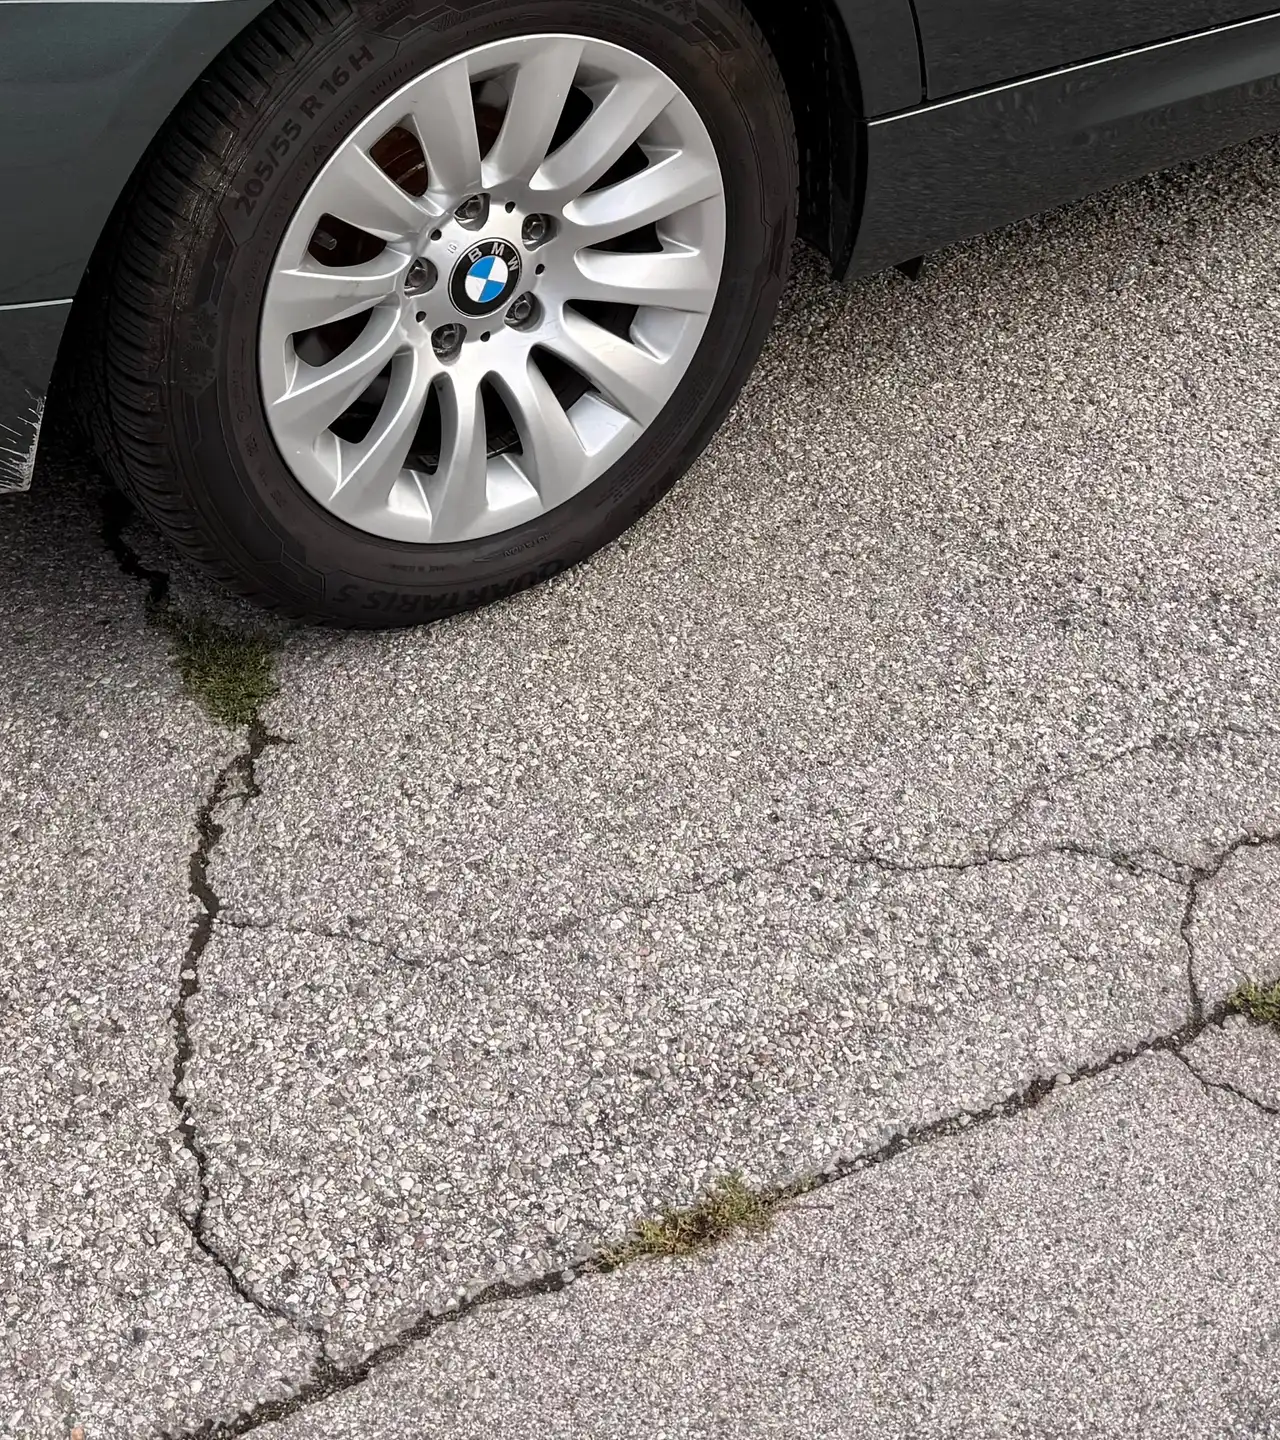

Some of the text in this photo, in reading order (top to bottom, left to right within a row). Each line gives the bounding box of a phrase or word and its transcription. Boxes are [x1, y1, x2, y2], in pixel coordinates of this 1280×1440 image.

[234, 118, 302, 217] 205/55
[299, 95, 325, 120] R
[319, 65, 350, 96] 16
[348, 44, 375, 72] H
[467, 241, 520, 273] BMW
